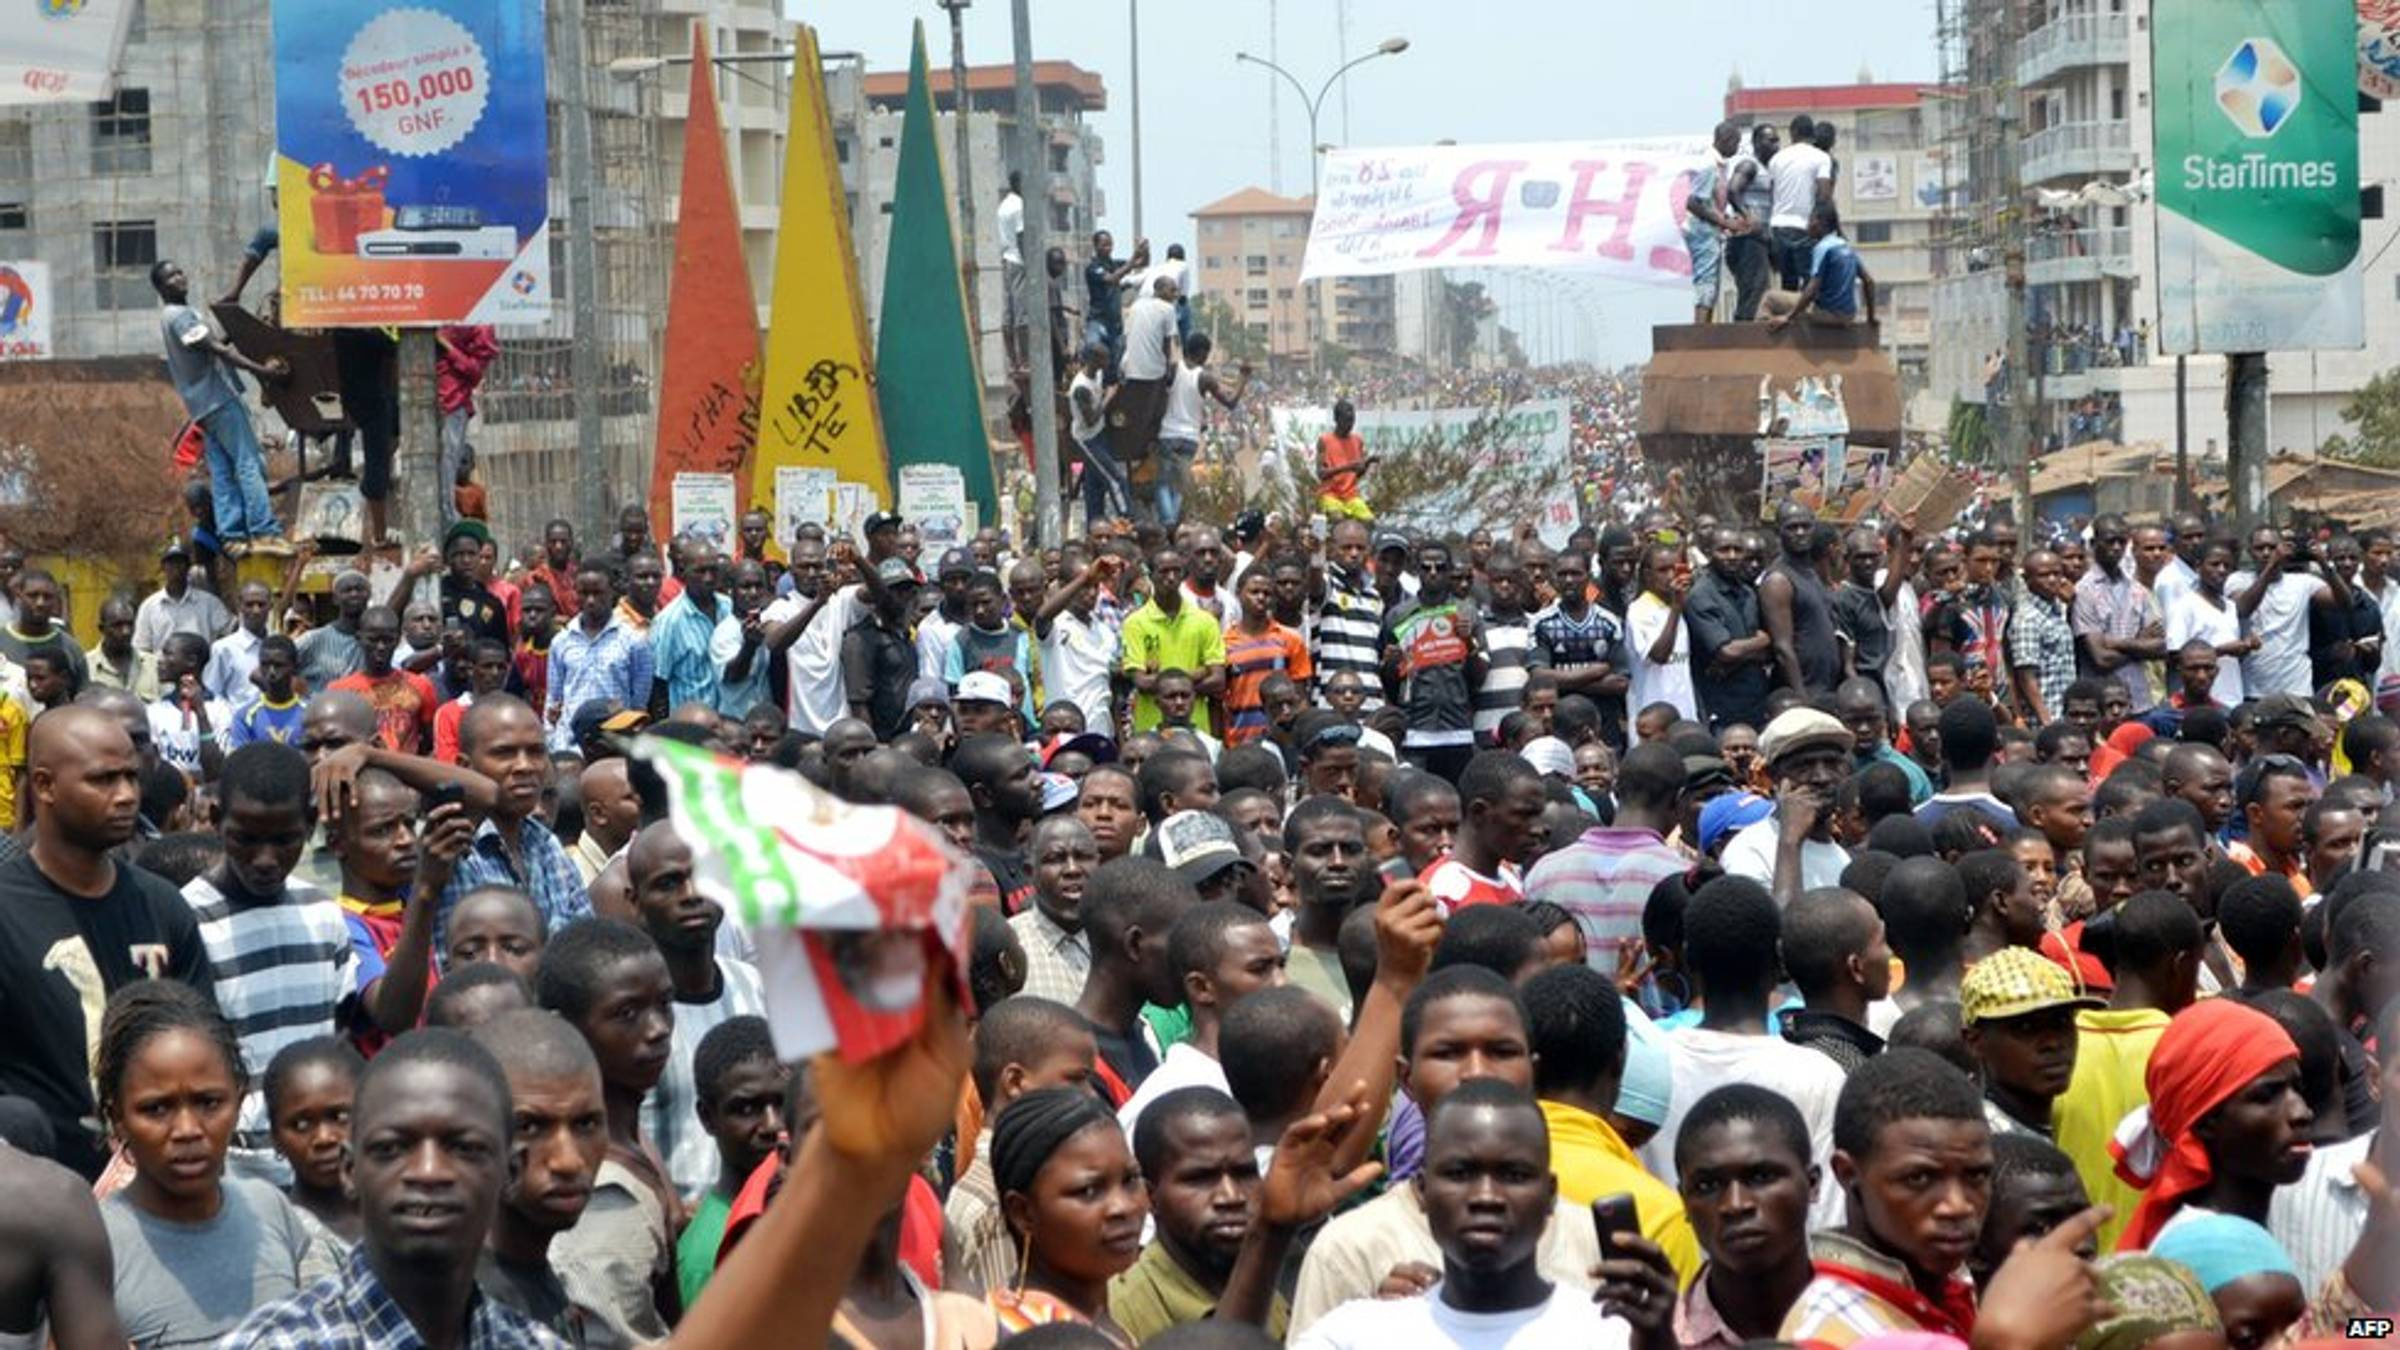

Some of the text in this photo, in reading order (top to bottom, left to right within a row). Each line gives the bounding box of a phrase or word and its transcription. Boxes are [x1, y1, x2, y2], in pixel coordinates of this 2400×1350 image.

[356, 66, 474, 114] 150,000
[2183, 153, 2338, 190] StarTimes
[359, 285, 380, 300] 70
[382, 284, 402, 299] 70
[403, 283, 425, 299] 70
